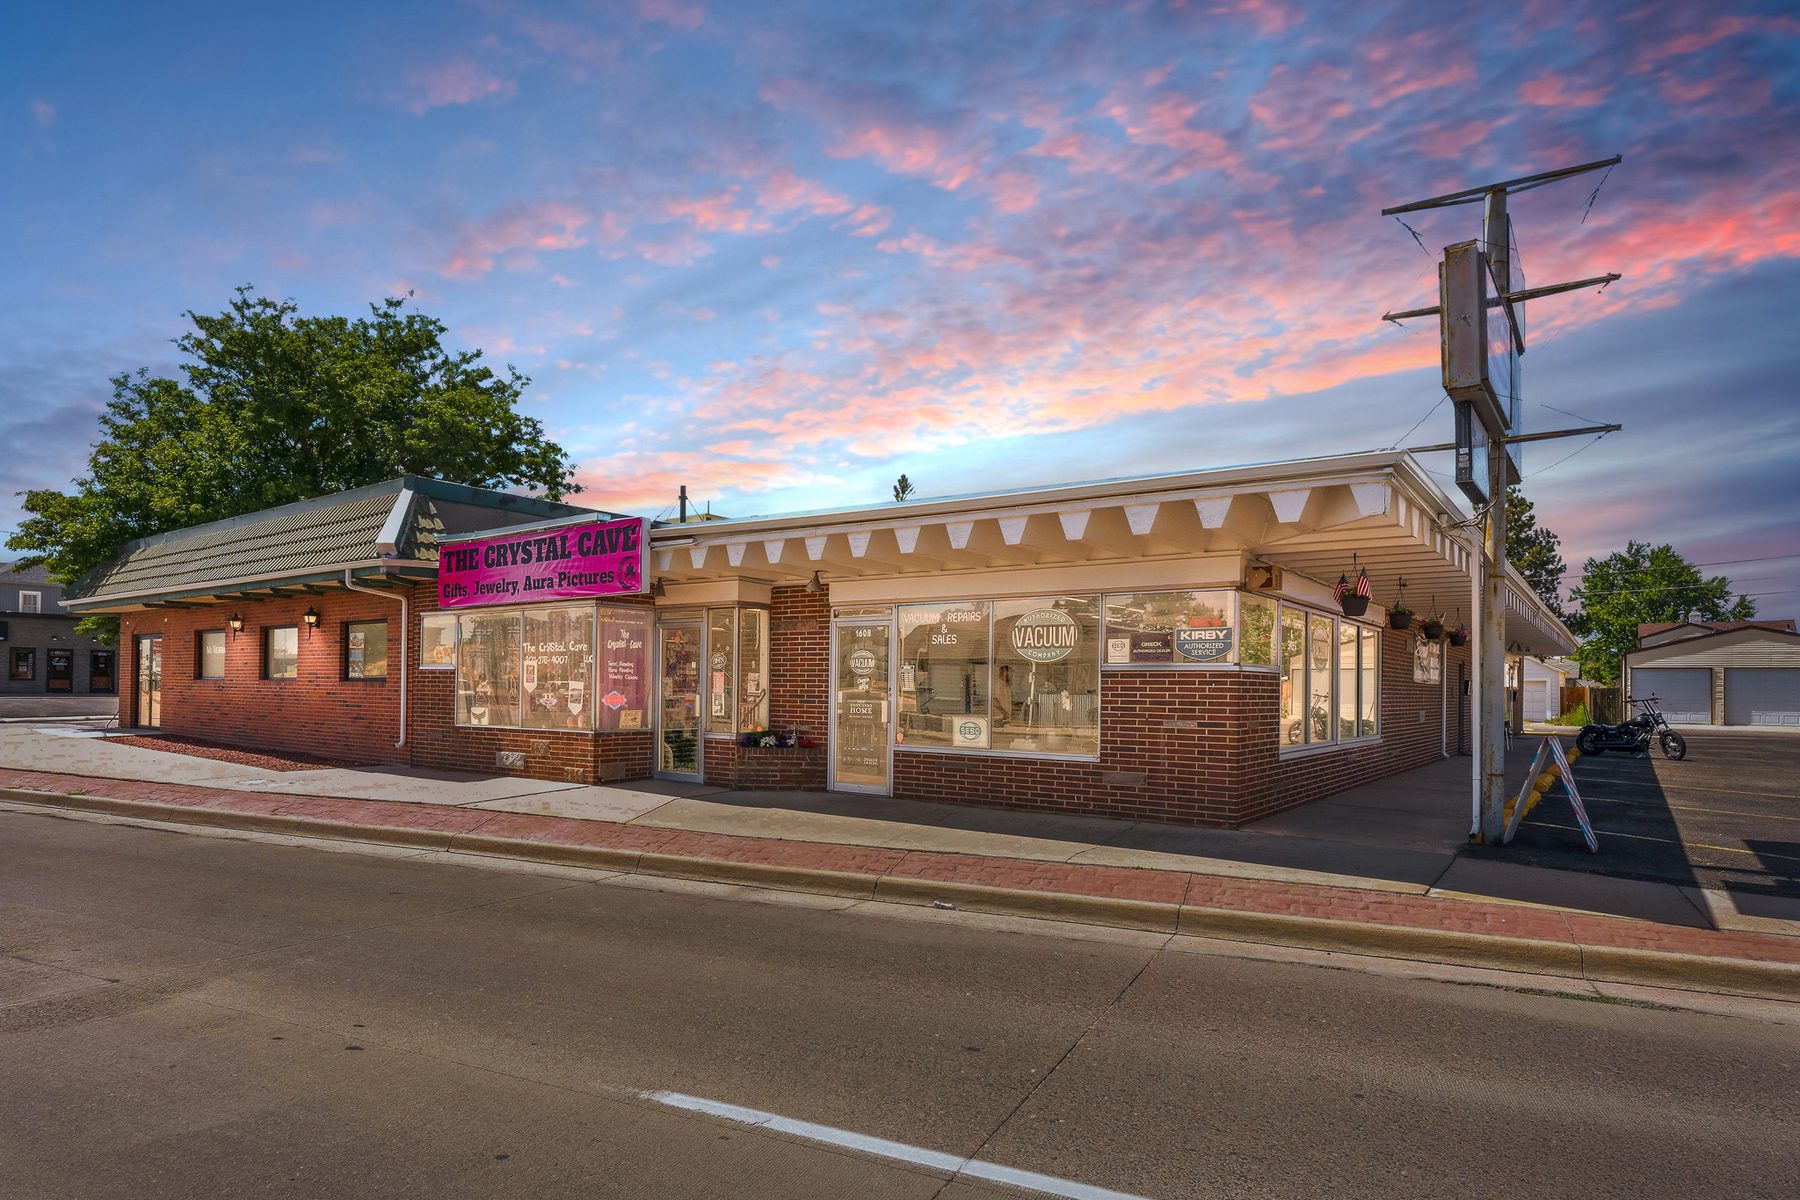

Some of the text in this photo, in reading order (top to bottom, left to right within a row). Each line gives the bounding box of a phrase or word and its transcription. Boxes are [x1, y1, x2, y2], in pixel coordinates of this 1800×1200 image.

[444, 525, 638, 573] THE CRYSTAL CAVE
[443, 570, 614, 598] Gifts, Jewelry, Aura Pictures
[904, 611, 982, 623] VACUUM REPAIRS
[1023, 612, 1066, 623] AUTHORIZED
[941, 624, 948, 633] &
[931, 634, 957, 644] SALES
[1015, 626, 1075, 647] VACUUM
[1180, 630, 1227, 640] KIRBY
[523, 642, 536, 653] The
[569, 640, 588, 652] Cave
[1184, 642, 1224, 650] AUTHORIZED
[1028, 650, 1060, 658] COMPANY
[960, 727, 981, 735] SEBO
